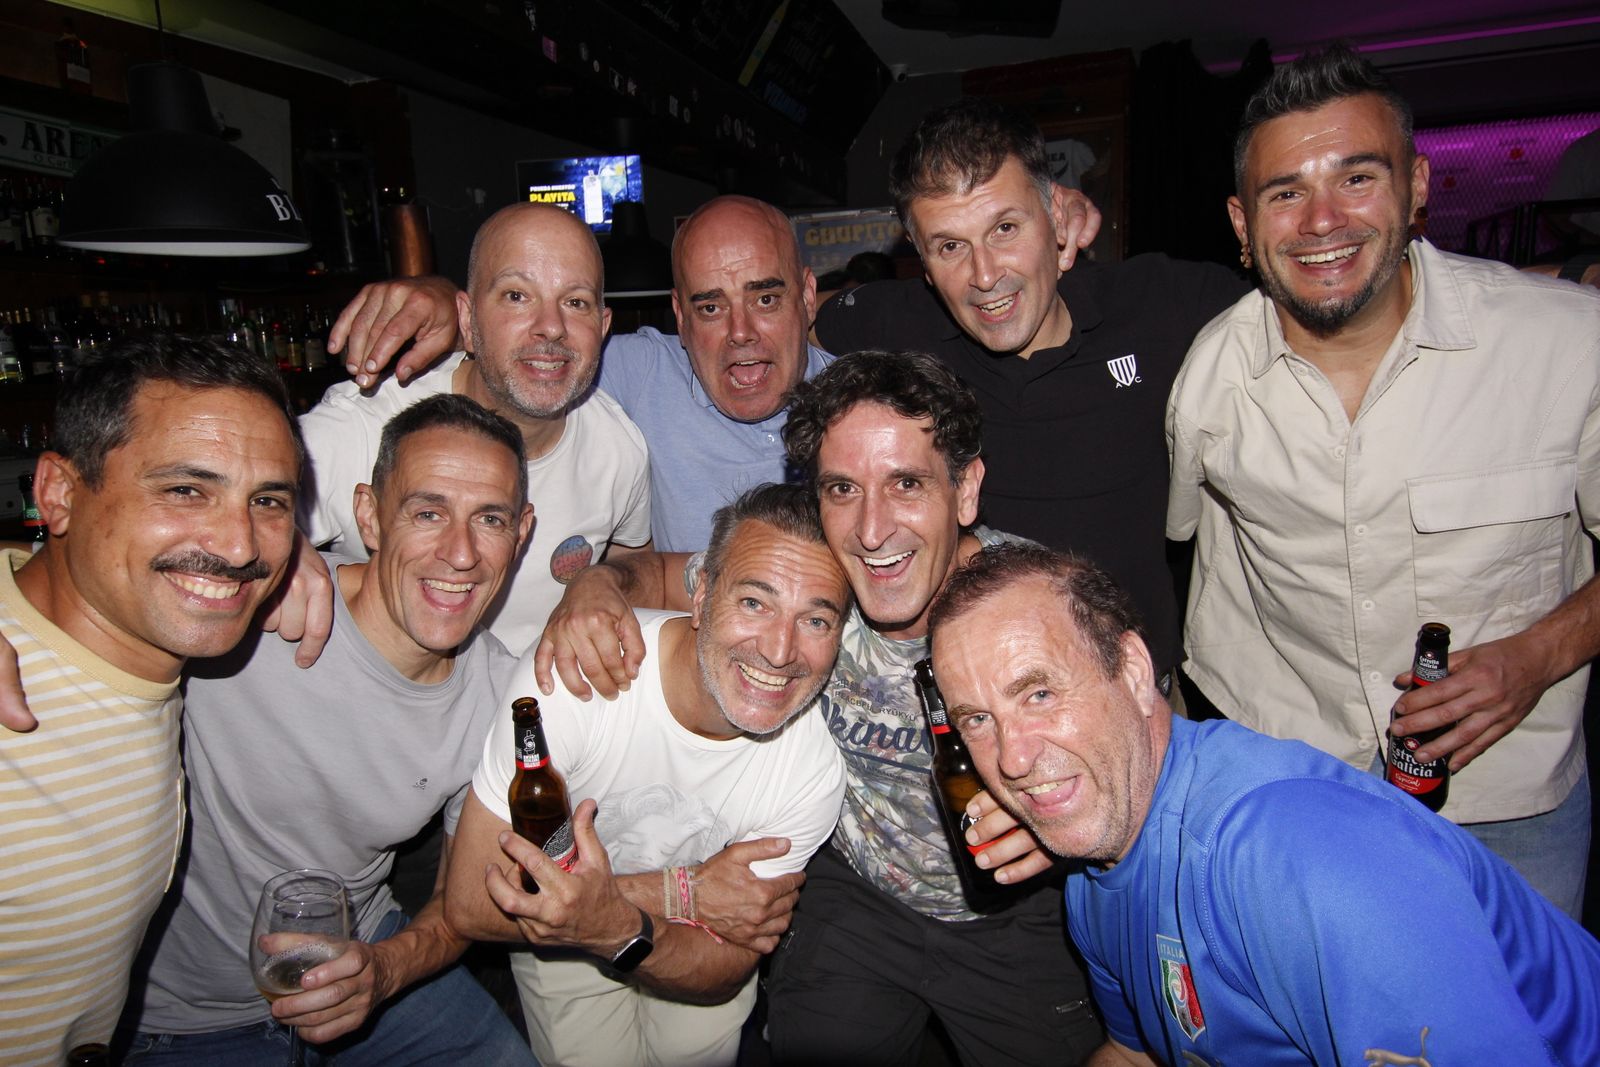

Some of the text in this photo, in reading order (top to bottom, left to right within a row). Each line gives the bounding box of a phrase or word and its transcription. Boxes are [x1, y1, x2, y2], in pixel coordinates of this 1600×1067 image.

[529, 191, 576, 203] PLAYITA
[1391, 742, 1437, 767] Estra
[1160, 943, 1186, 960] ITALIA
